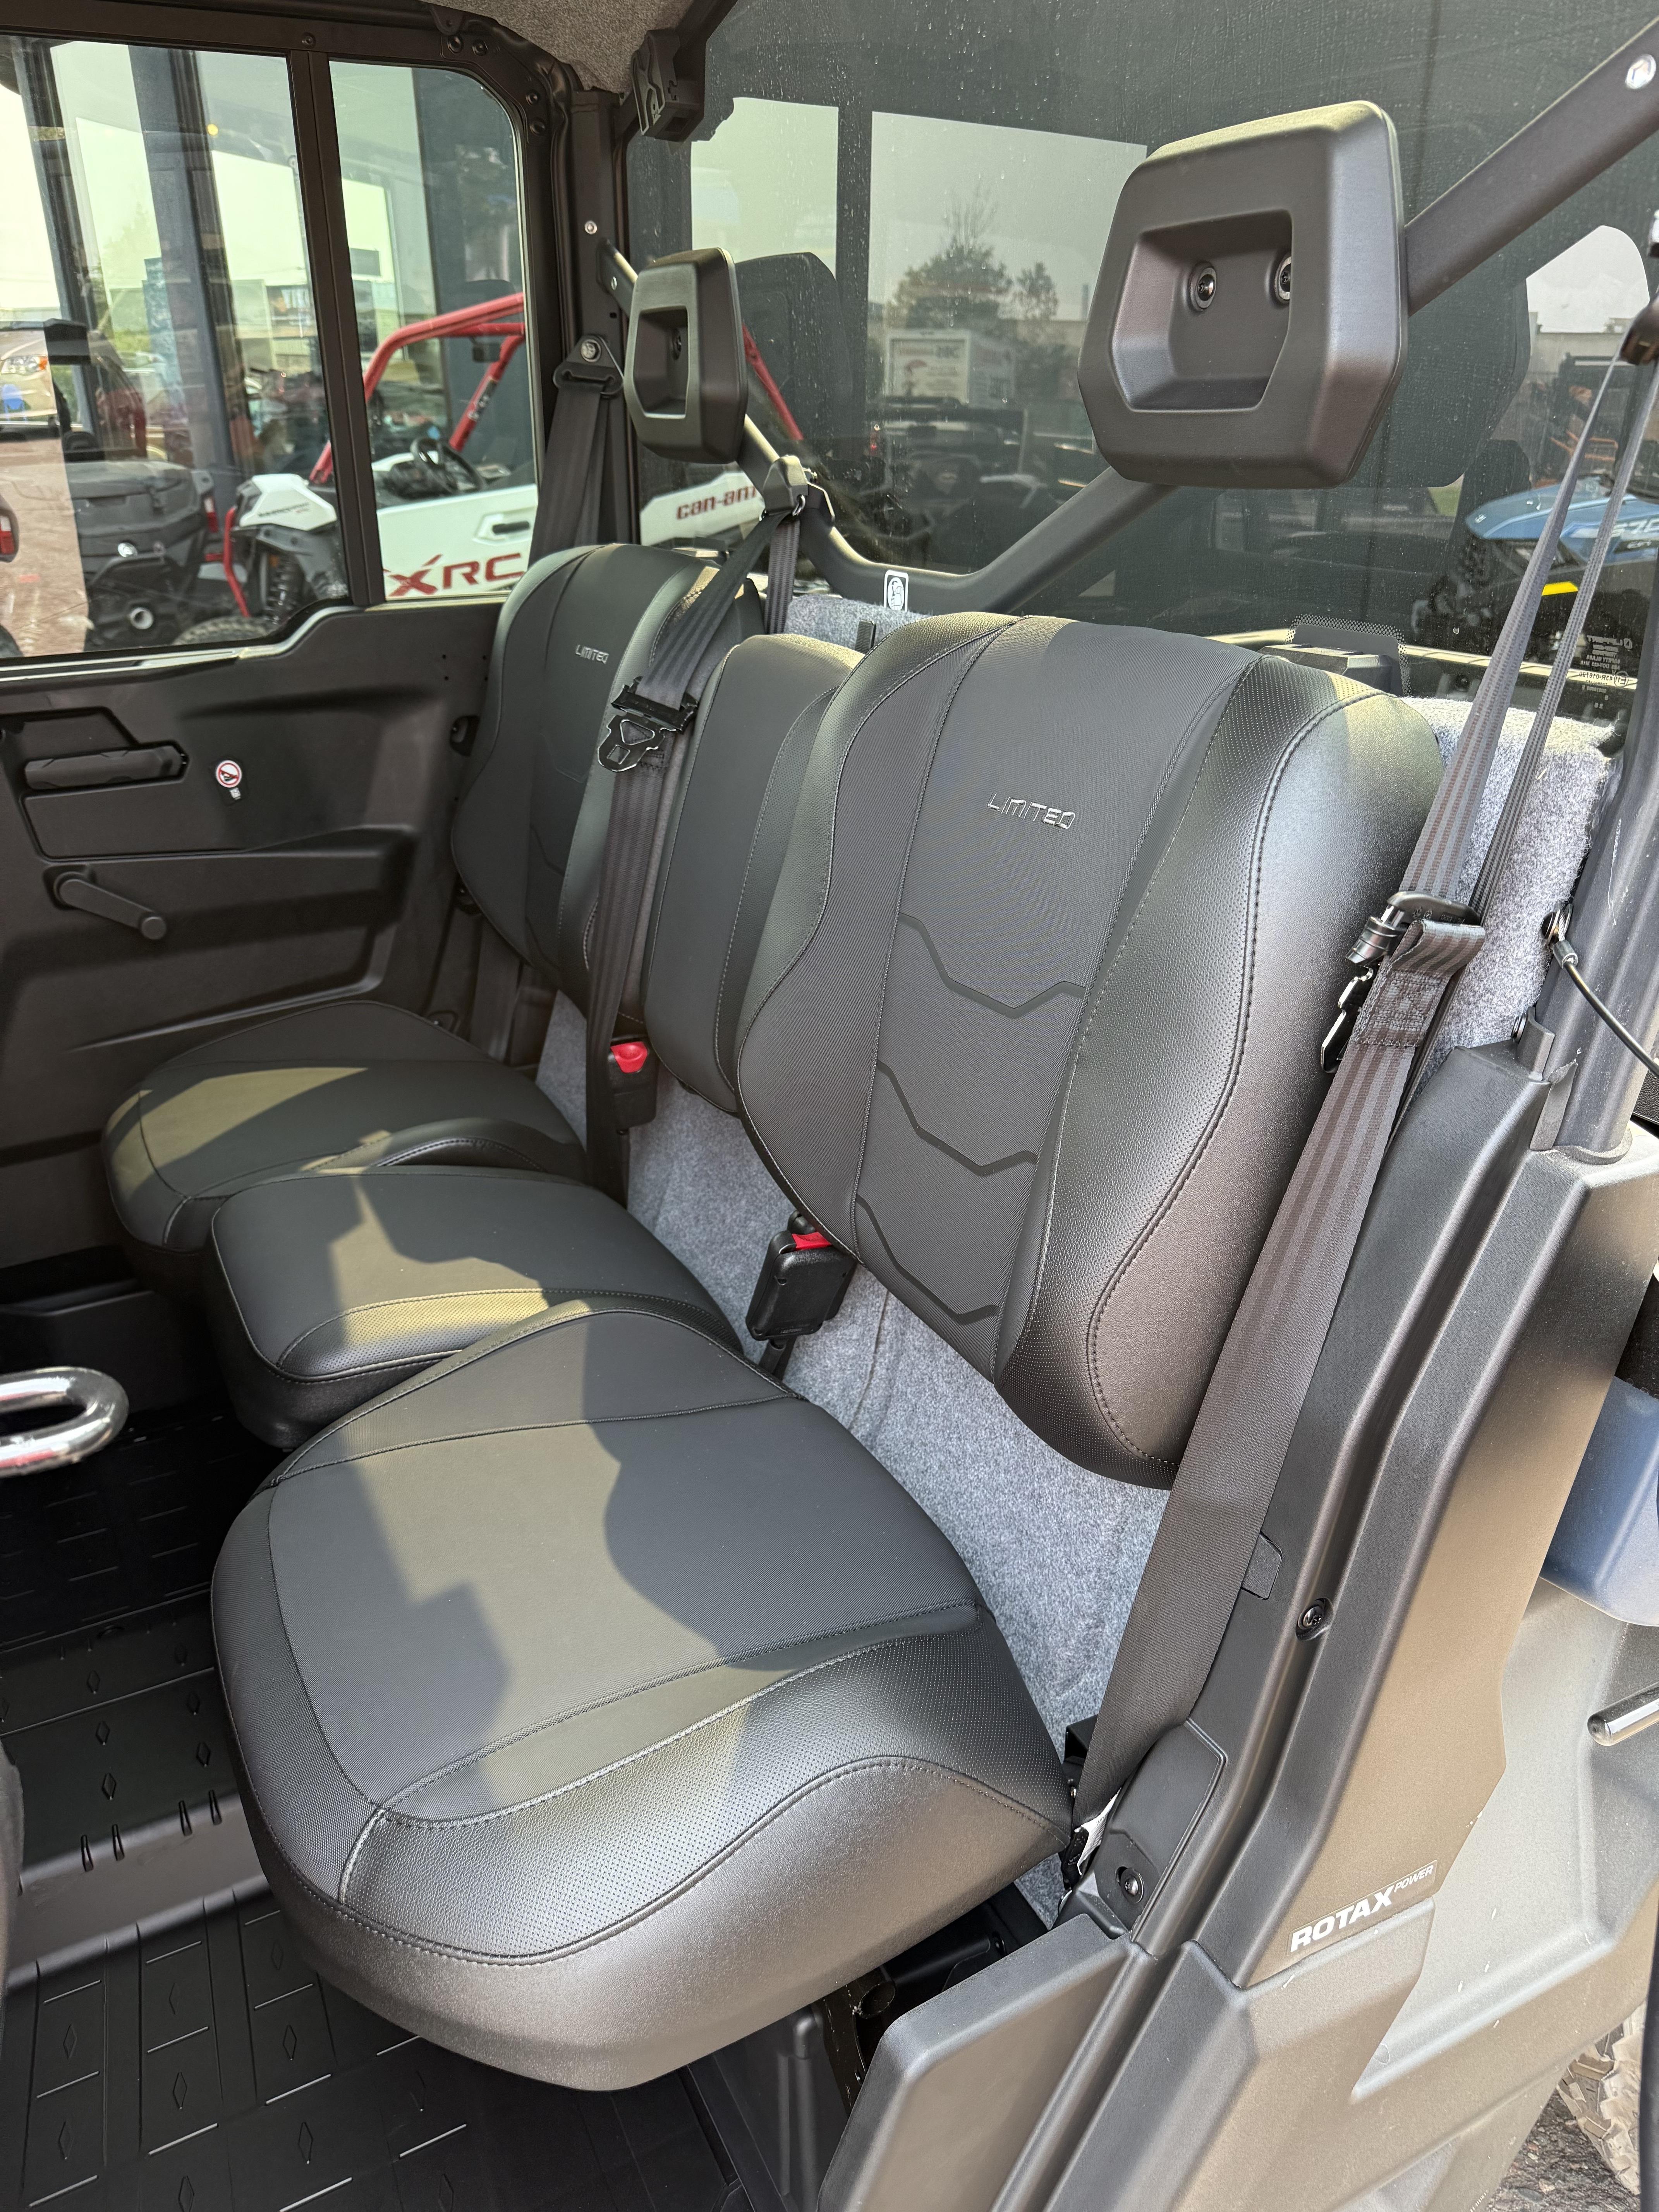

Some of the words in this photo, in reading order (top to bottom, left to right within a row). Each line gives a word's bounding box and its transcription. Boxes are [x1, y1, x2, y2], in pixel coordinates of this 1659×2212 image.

[677, 486, 756, 520] can-am
[383, 554, 524, 596] XRC
[575, 644, 609, 664] LIMITED
[988, 793, 1075, 829] LIMITED
[1290, 1885, 1394, 1953] ROTAX
[1394, 1865, 1433, 1893] POWER
